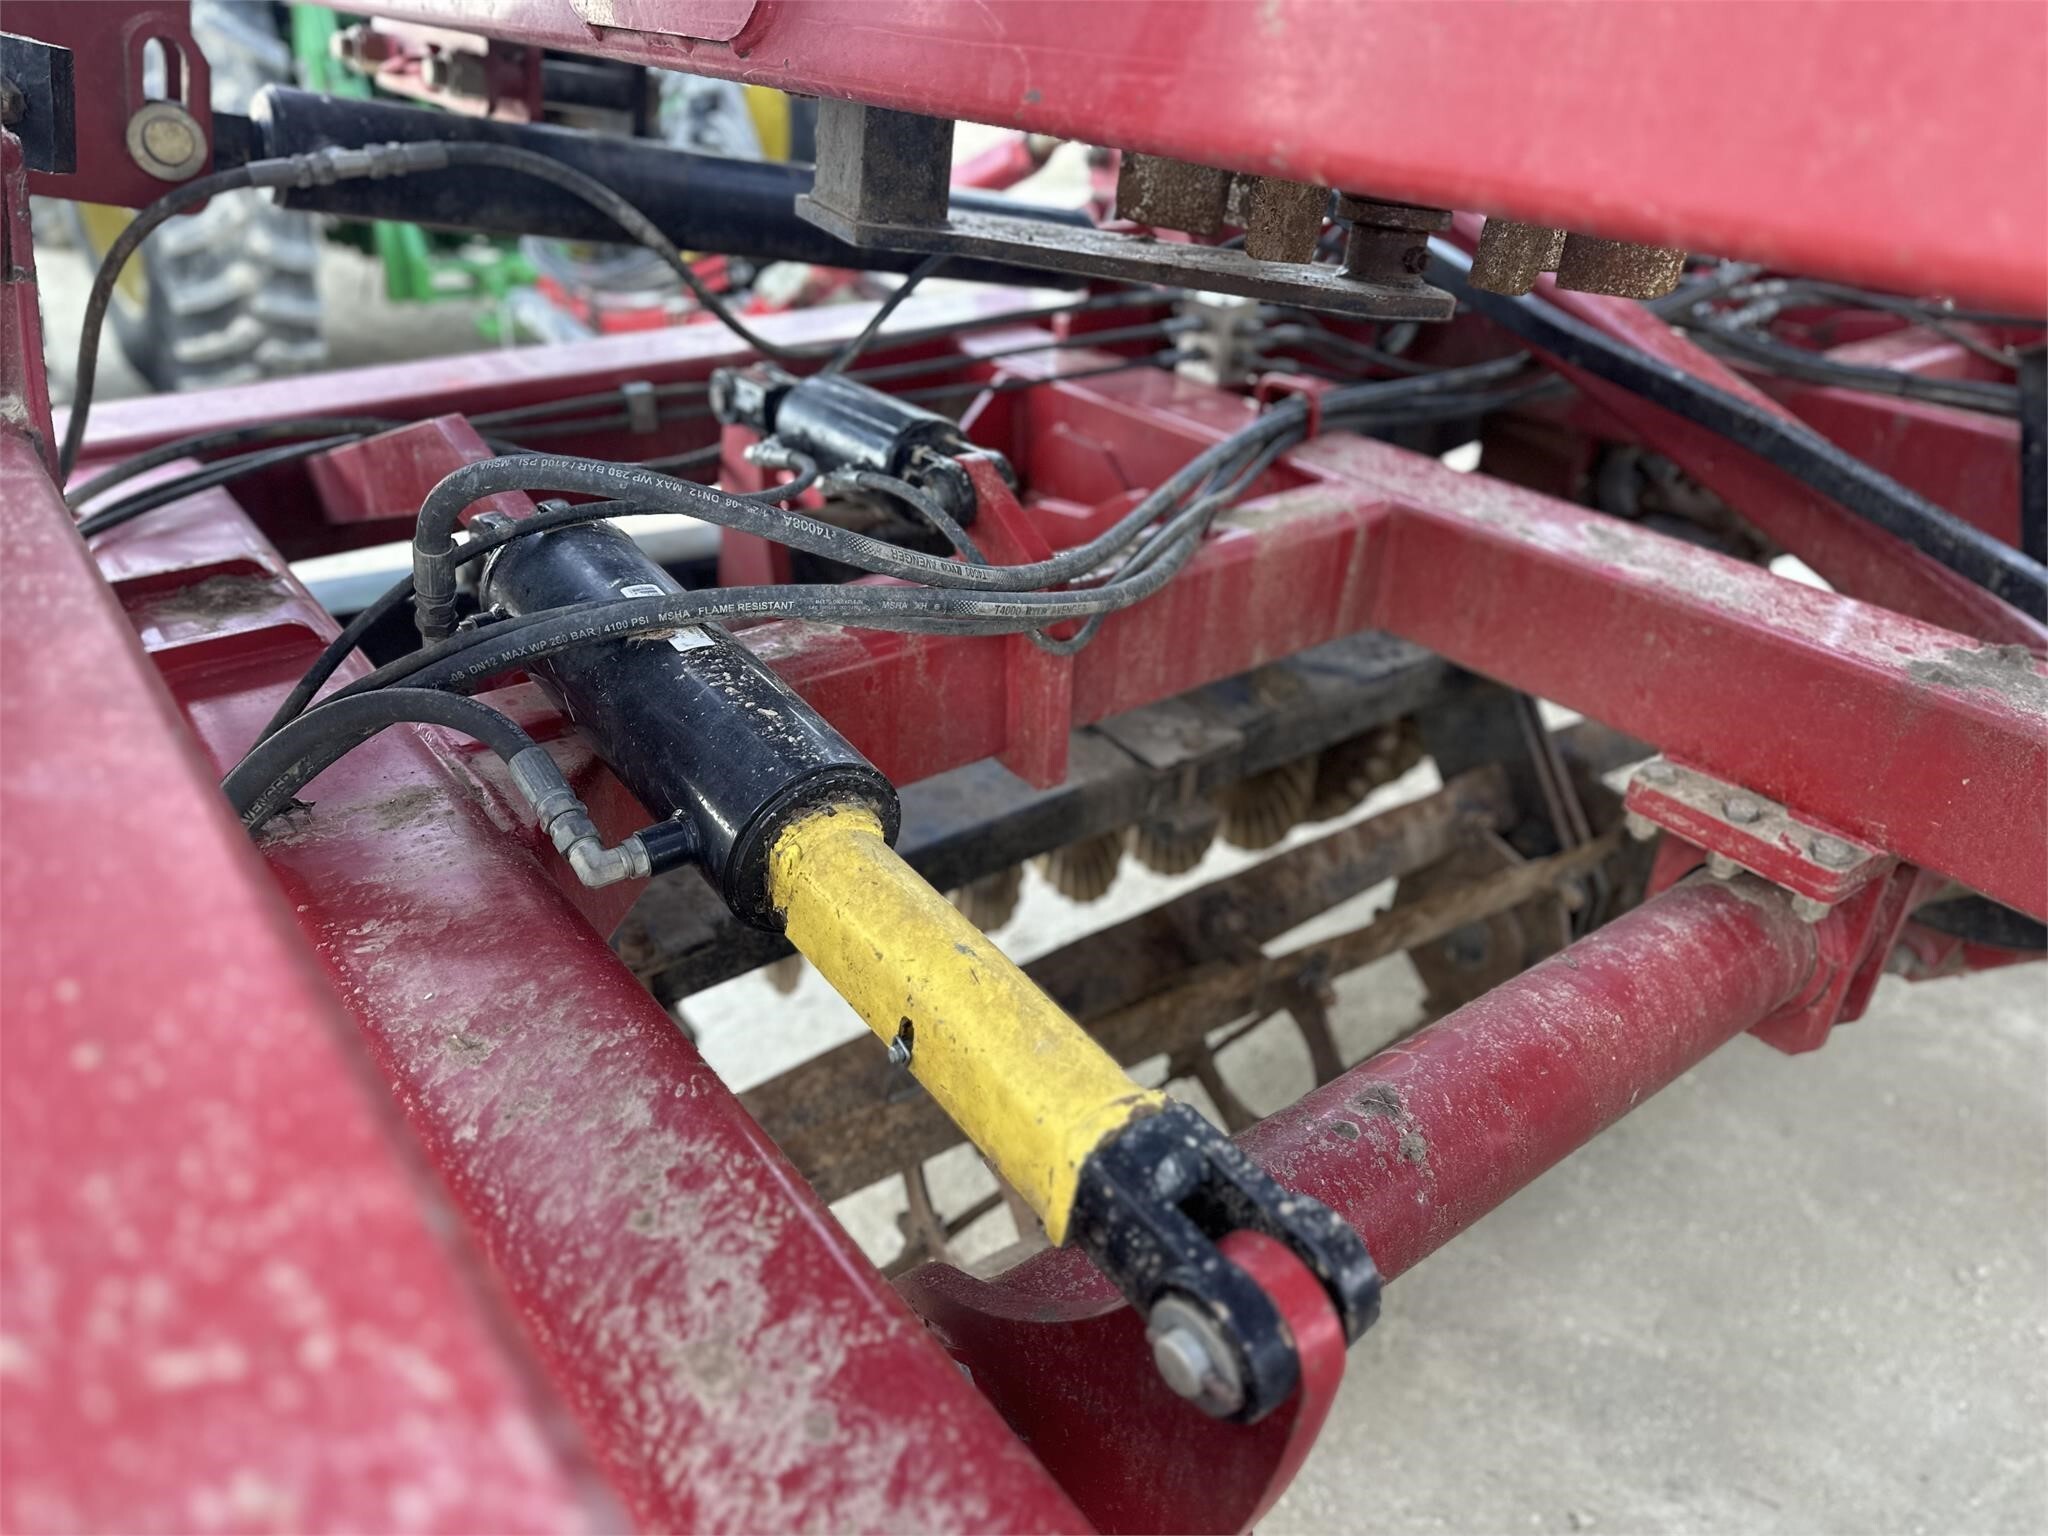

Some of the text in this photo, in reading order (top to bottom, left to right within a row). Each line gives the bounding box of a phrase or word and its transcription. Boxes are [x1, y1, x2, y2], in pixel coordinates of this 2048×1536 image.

[480, 459, 510, 470] MSHA
[519, 458, 538, 466] PSI
[541, 458, 570, 468] 4100
[579, 462, 605, 474] BAR
[608, 467, 630, 479] 280
[632, 473, 653, 485] WP
[656, 477, 683, 492] MAX
[689, 487, 720, 503] DN12
[783, 514, 832, 540] T4008A
[965, 566, 987, 580] T4000
[995, 604, 1022, 615] T4000
[449, 670, 465, 683] -08
[469, 656, 499, 675] DN12
[501, 646, 528, 662] MAX
[528, 640, 548, 653] WP
[570, 626, 597, 641] BAR
[603, 620, 630, 634] 4100
[630, 615, 650, 628] PSI
[657, 609, 692, 622] MSHA
[698, 603, 736, 616] FLAME
[737, 601, 795, 612] RESISTANT
